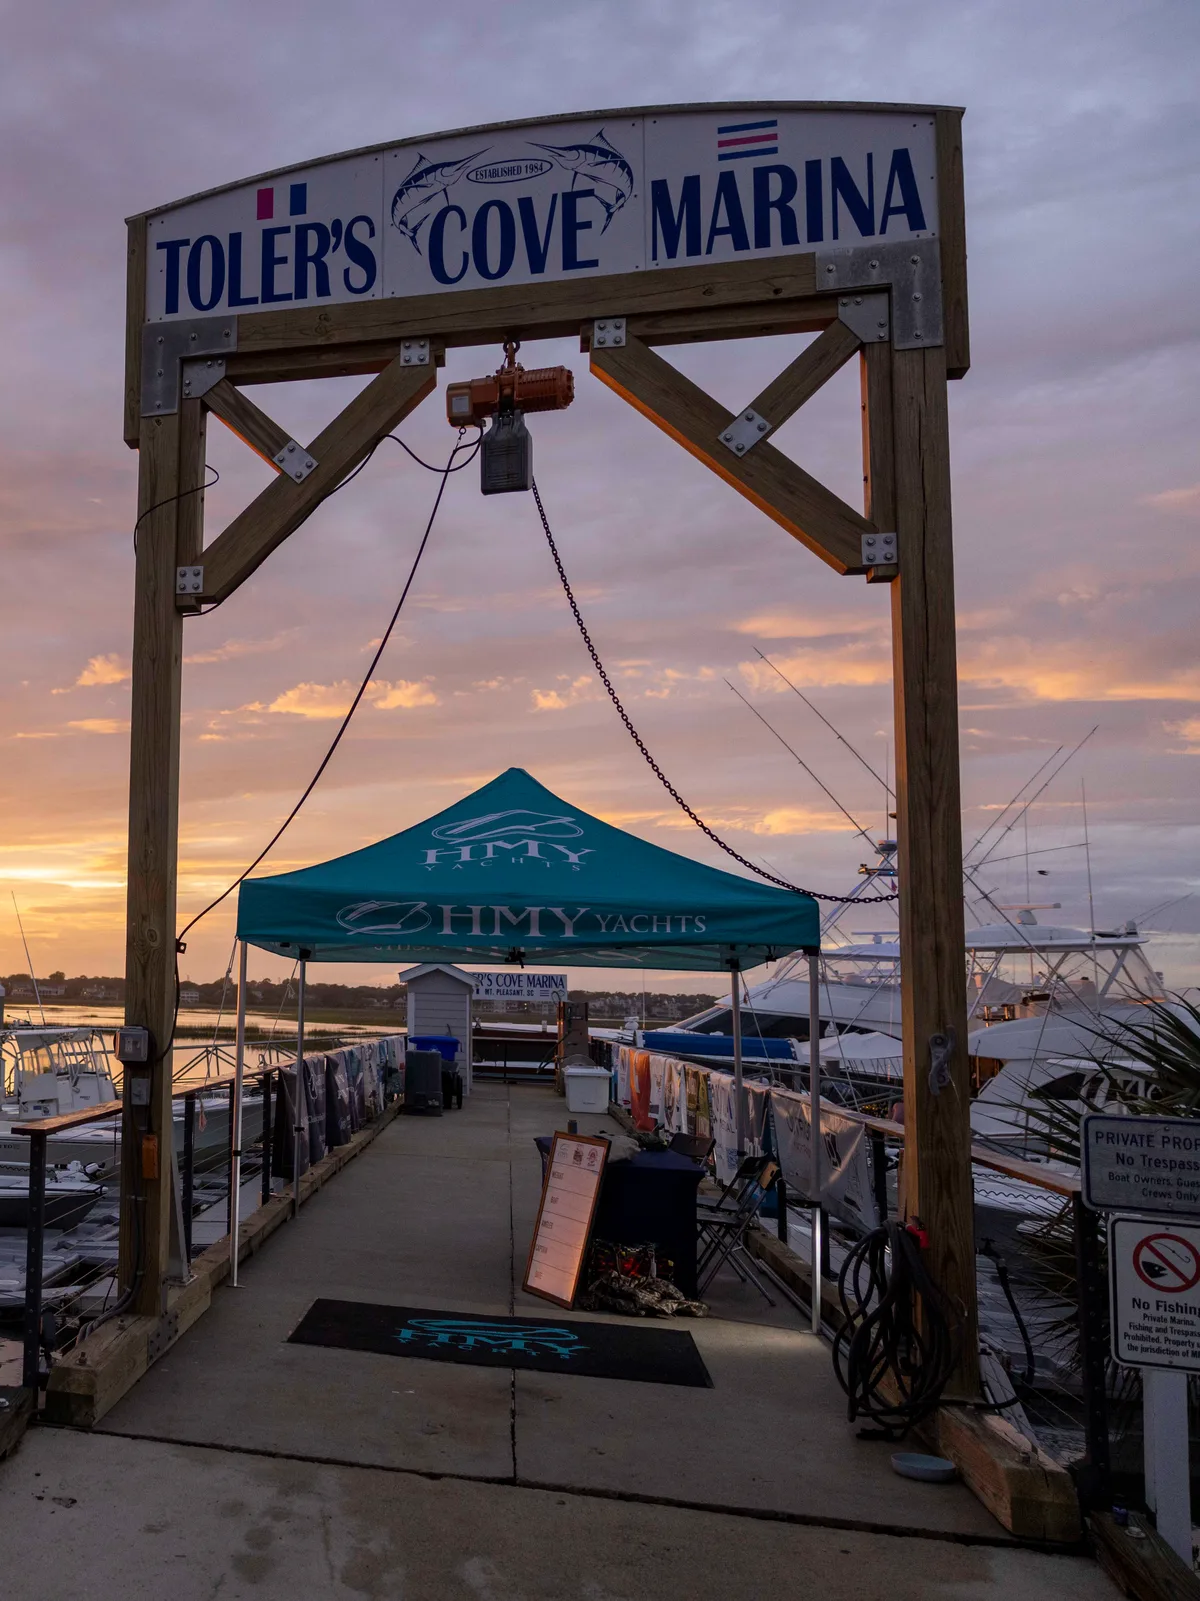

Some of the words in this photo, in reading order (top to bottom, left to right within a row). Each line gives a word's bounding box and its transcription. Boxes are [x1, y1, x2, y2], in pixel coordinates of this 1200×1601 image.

[475, 165, 522, 180] ESTABLISHED
[524, 162, 543, 174] 1984
[156, 214, 377, 315] TOLER'S
[428, 188, 600, 285] COVE
[651, 147, 926, 262] MARINA
[416, 839, 597, 865] HMY
[424, 857, 581, 872] YACHTS
[437, 904, 596, 938] HMY
[596, 913, 707, 934] YACHTS
[472, 973, 493, 987] R'S
[496, 974, 523, 988] COVE
[526, 975, 565, 989] MARINA
[526, 989, 535, 997] SC
[1095, 1131, 1155, 1148] PRIVATE
[1115, 1152, 1135, 1166] No
[1108, 1171, 1130, 1183] Boat
[1141, 1187, 1172, 1199] Crews
[1175, 1190, 1199, 1203] Only
[1132, 1297, 1150, 1310] No
[1143, 1313, 1168, 1323] Private
[1169, 1316, 1196, 1326] Marina.
[1128, 1322, 1153, 1333] Fishing
[1155, 1326, 1168, 1334] and
[1123, 1332, 1162, 1344] Prohibited.
[1164, 1336, 1195, 1348] Property
[1127, 1343, 1139, 1352] the
[1140, 1344, 1180, 1357] jurisdiction
